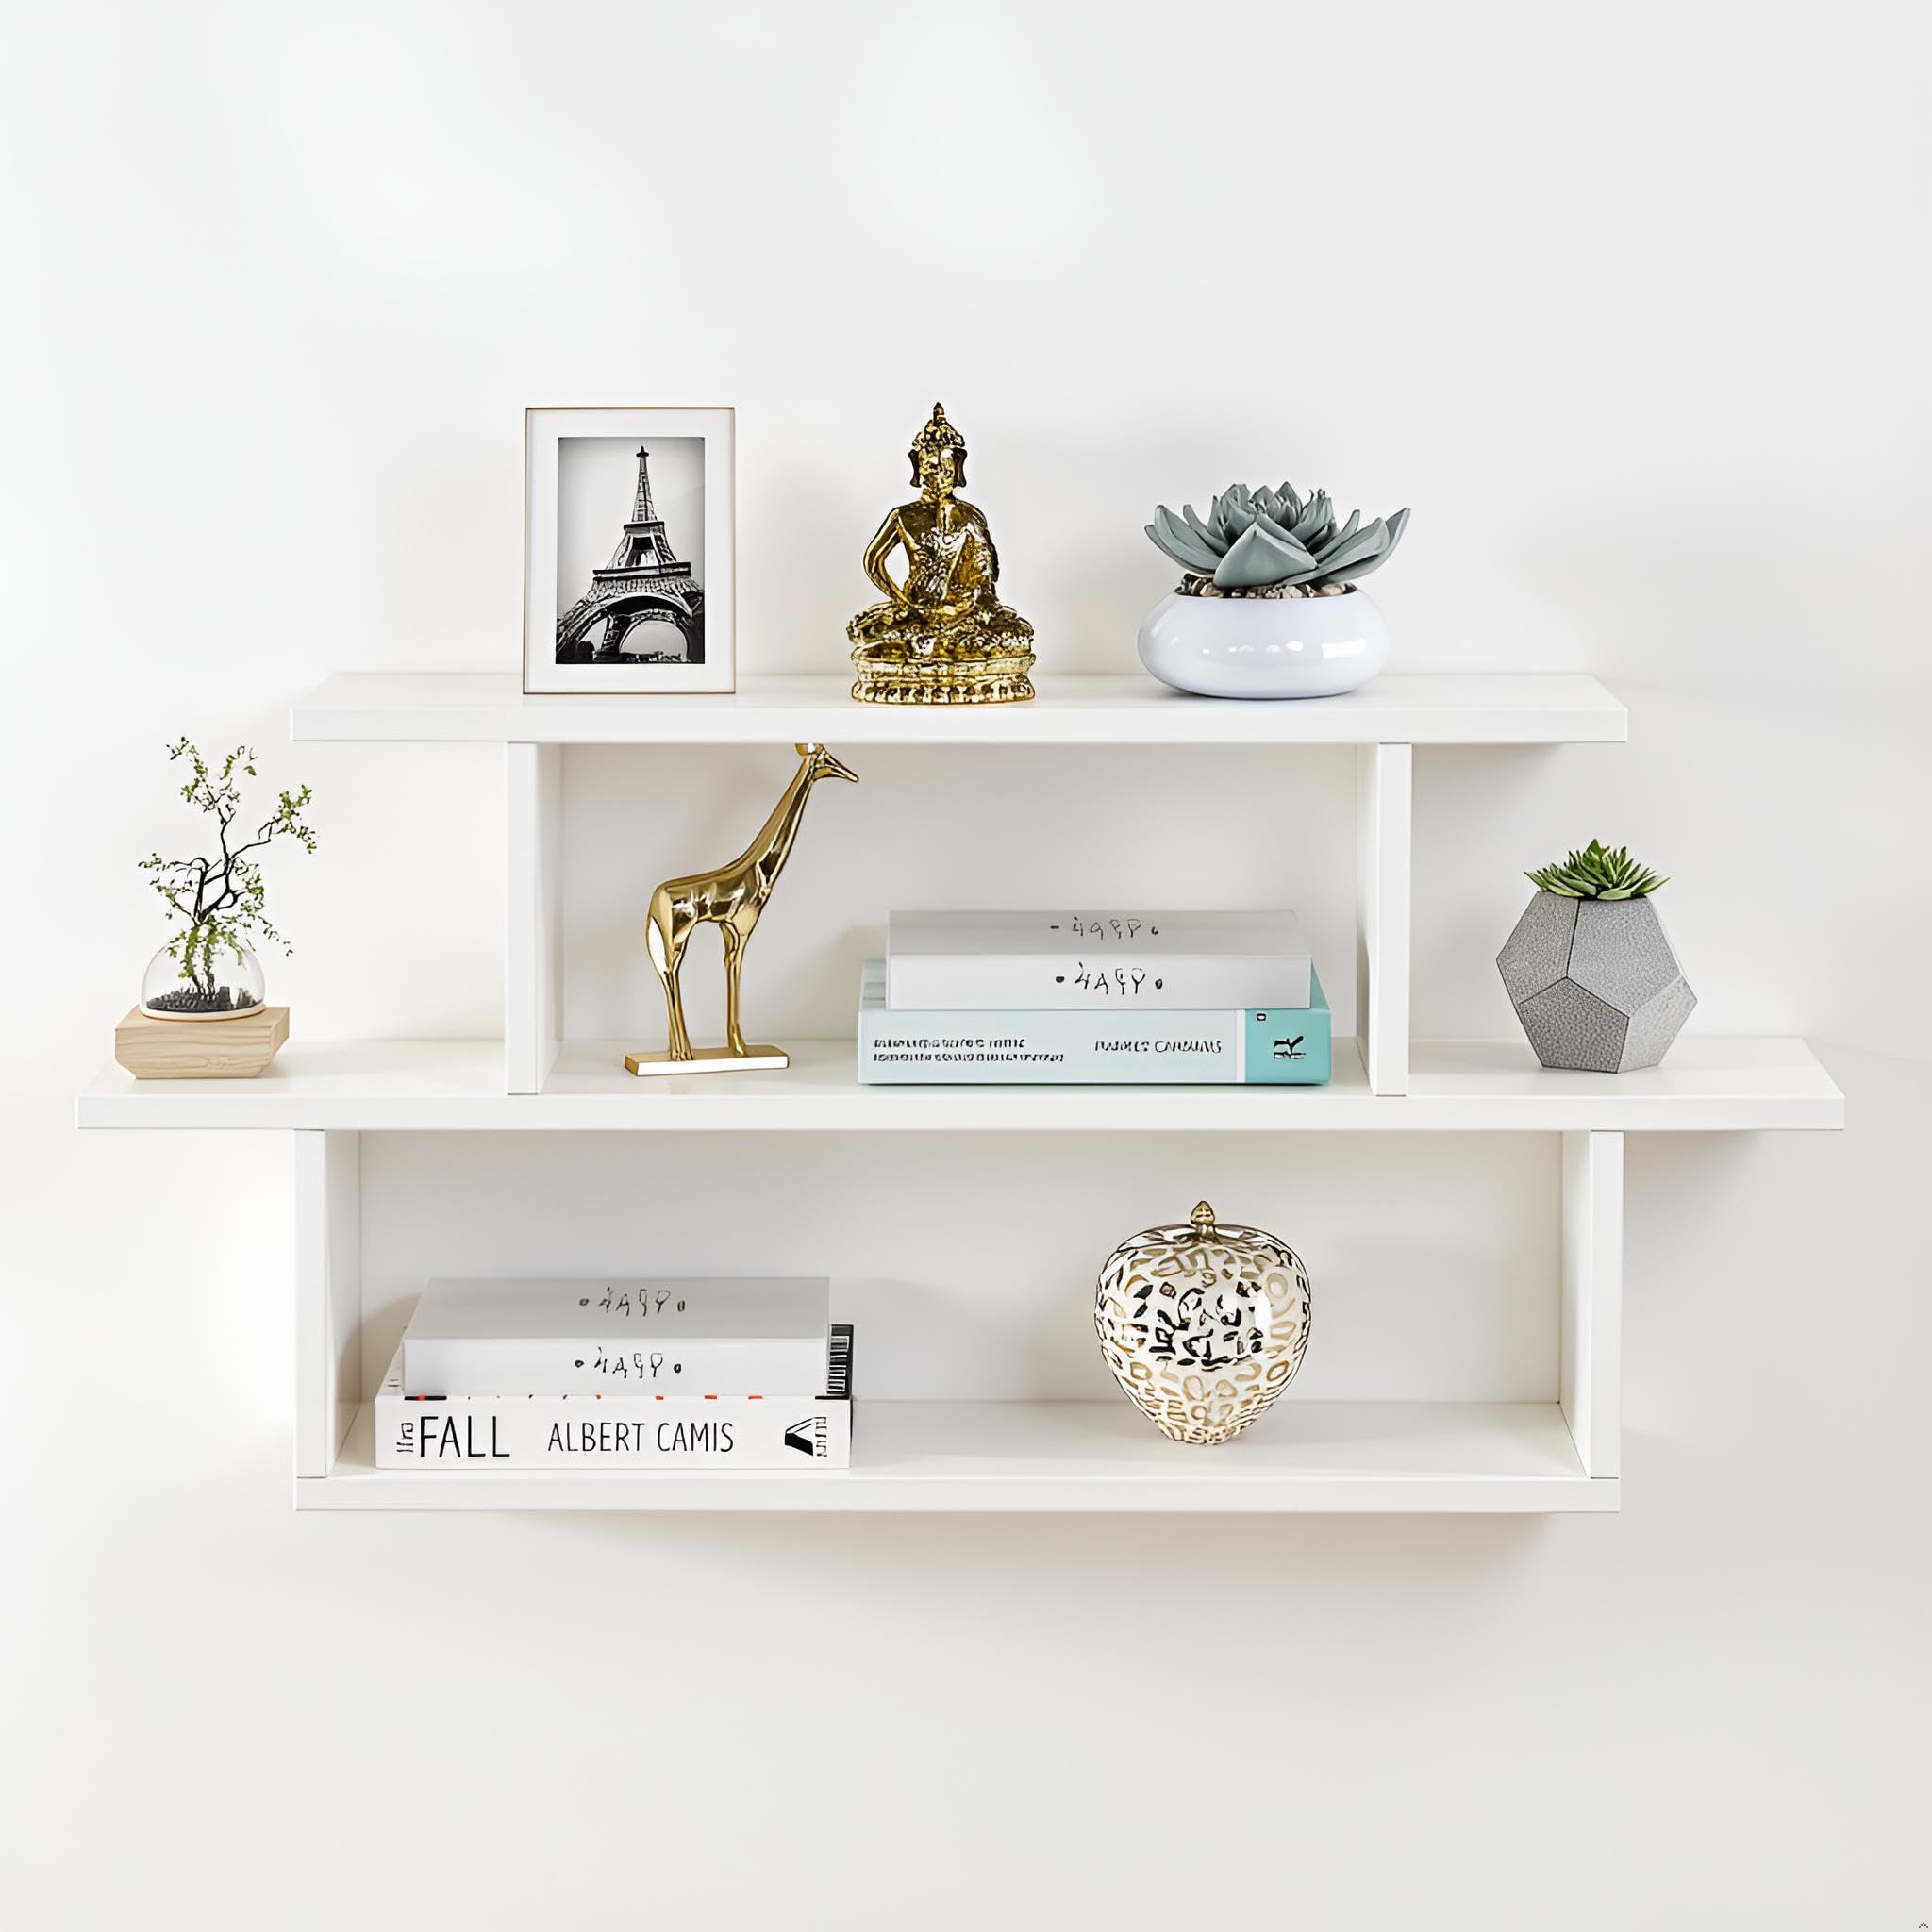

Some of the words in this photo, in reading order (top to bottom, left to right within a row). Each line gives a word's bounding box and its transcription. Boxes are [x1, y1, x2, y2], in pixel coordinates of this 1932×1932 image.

[420, 1415, 510, 1458] FALL
[547, 1422, 645, 1452] ALBERT
[657, 1422, 734, 1453] CAMIS
